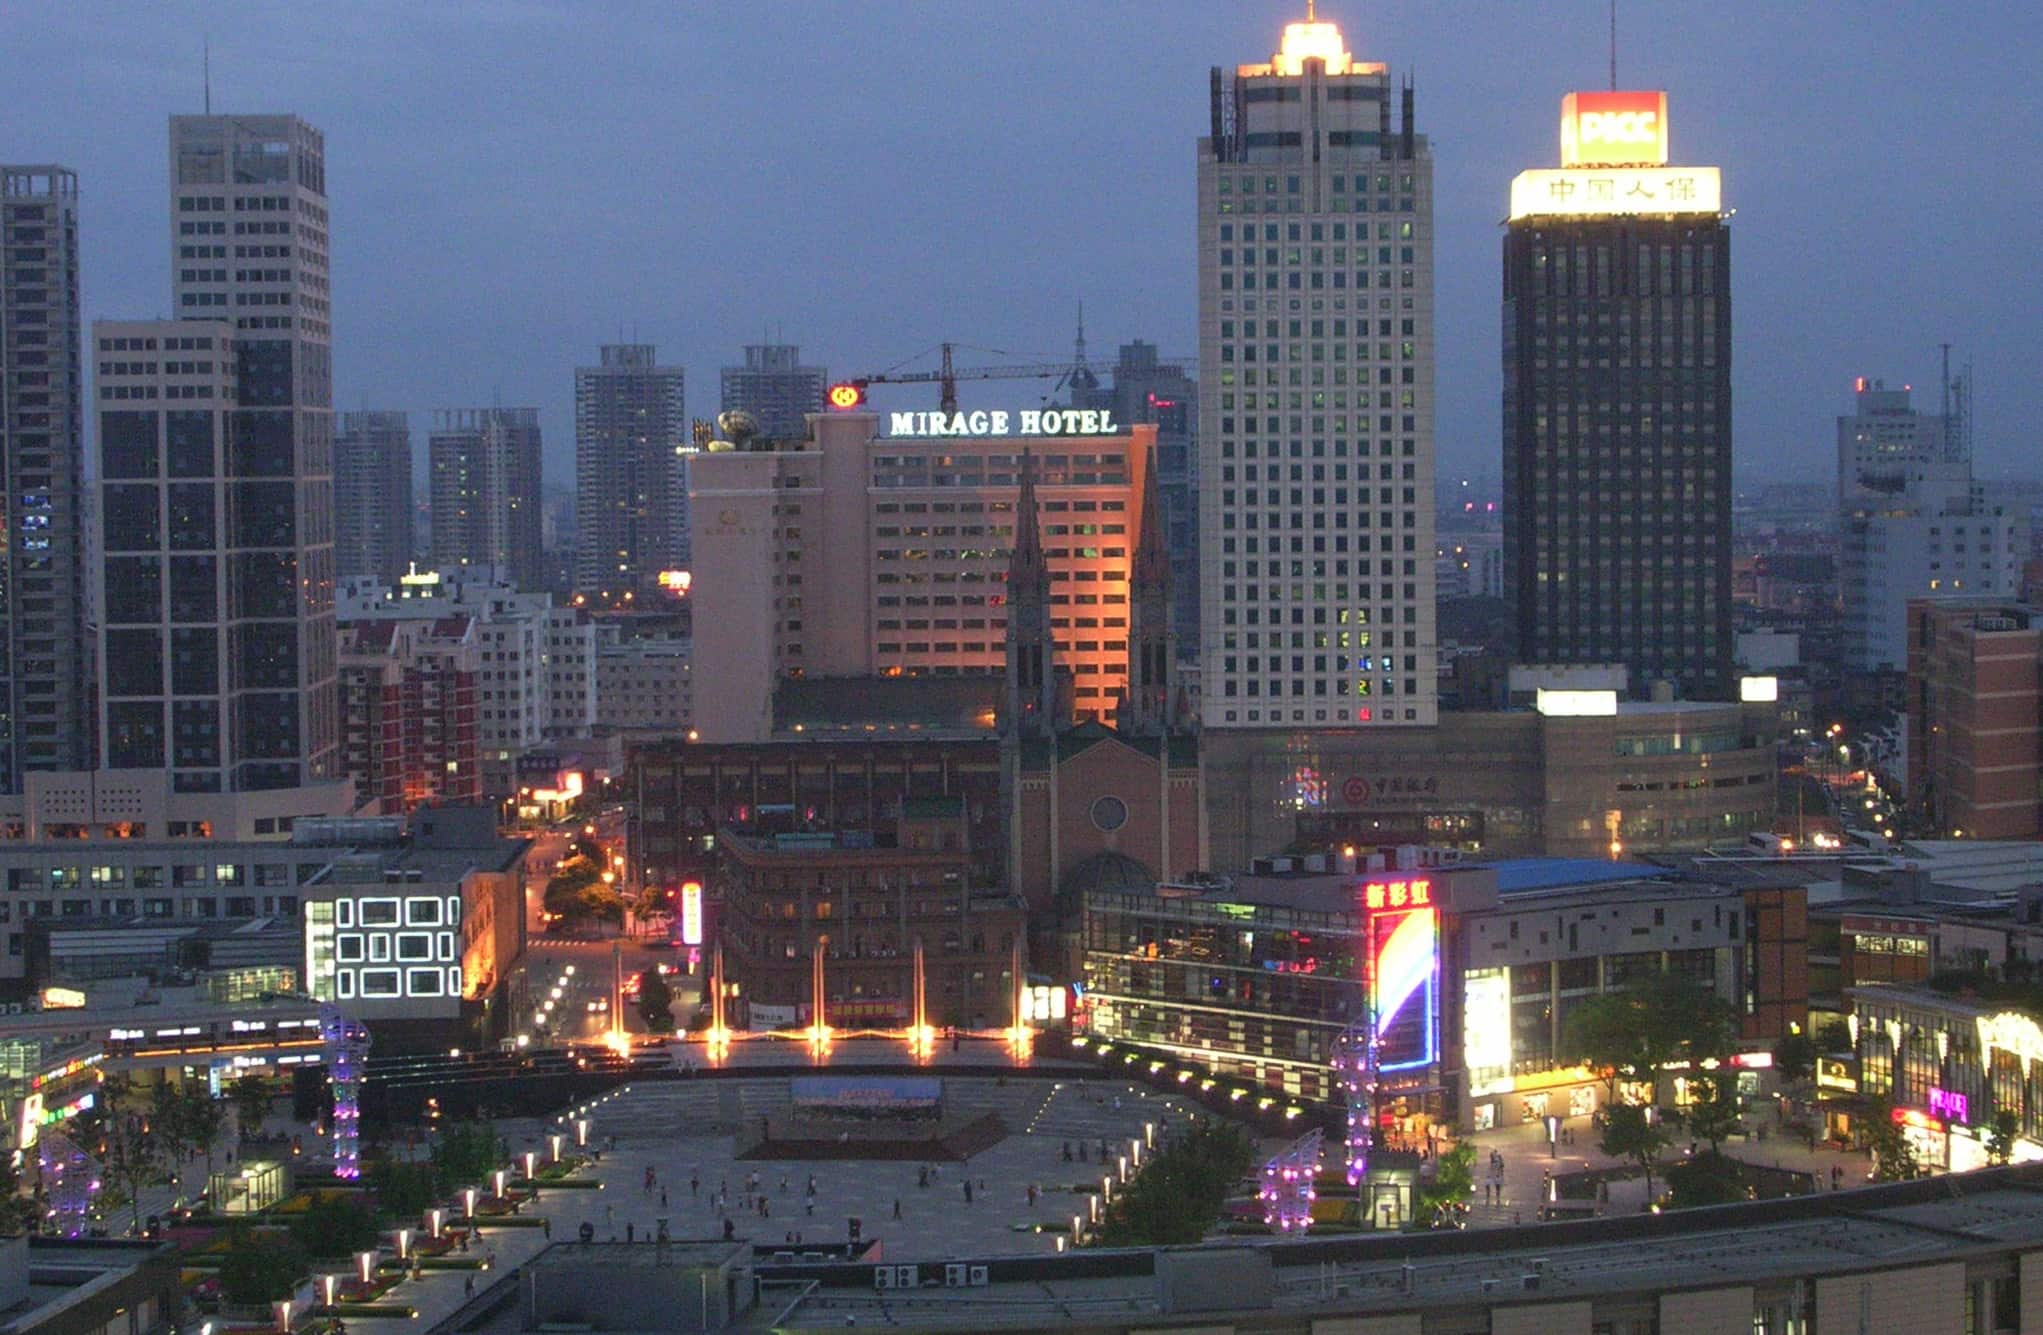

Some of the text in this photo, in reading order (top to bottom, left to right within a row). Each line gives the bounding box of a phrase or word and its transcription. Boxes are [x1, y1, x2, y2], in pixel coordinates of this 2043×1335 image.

[1579, 110, 1656, 144] PICC
[1549, 176, 1697, 204] 中国人保
[890, 409, 1118, 436] MIRAGE HOTEL
[1366, 880, 1430, 908] 新彩虹
